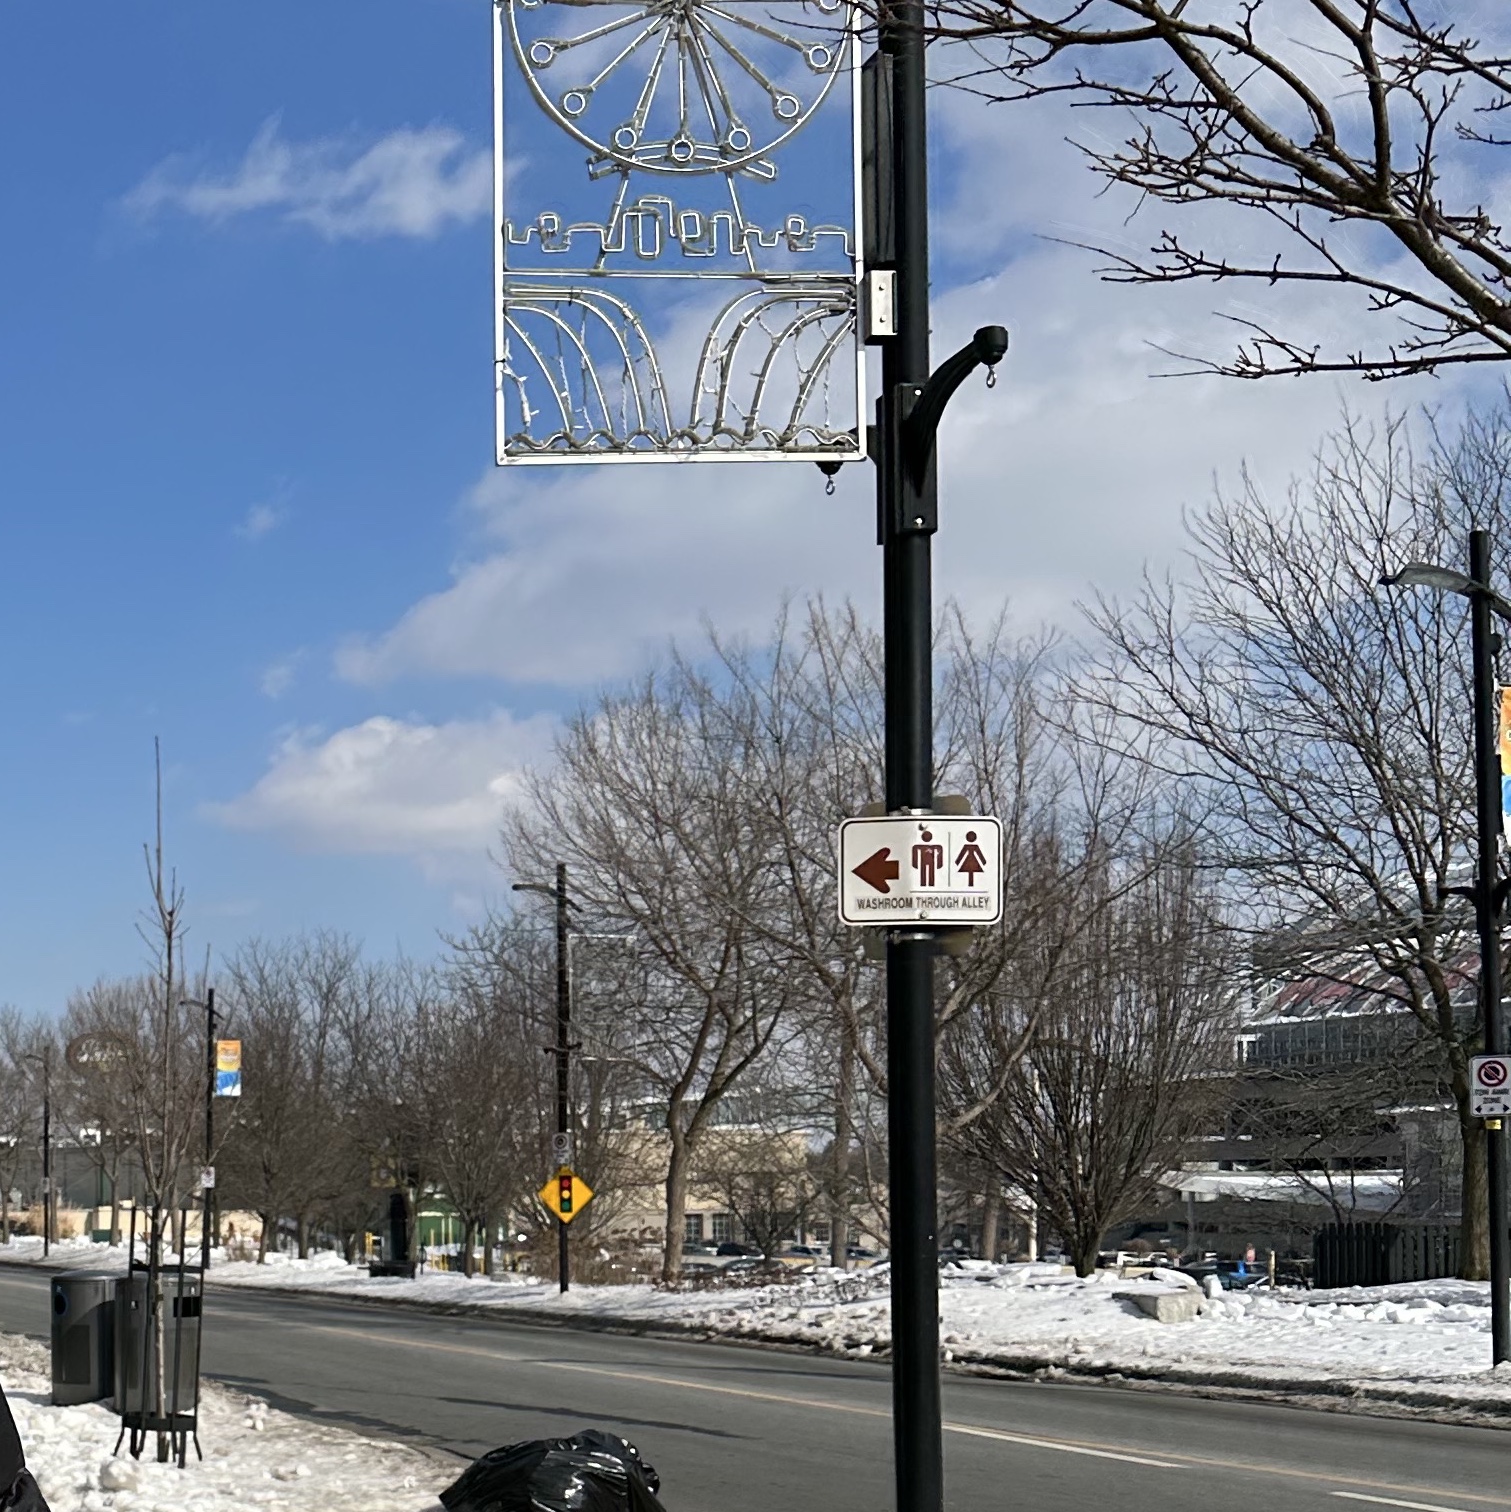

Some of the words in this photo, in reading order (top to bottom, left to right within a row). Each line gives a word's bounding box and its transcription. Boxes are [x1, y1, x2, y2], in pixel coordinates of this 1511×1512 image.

[857, 897, 913, 910] WASHROOM
[915, 896, 959, 909] THROUGH
[961, 896, 990, 909] ALLEY
